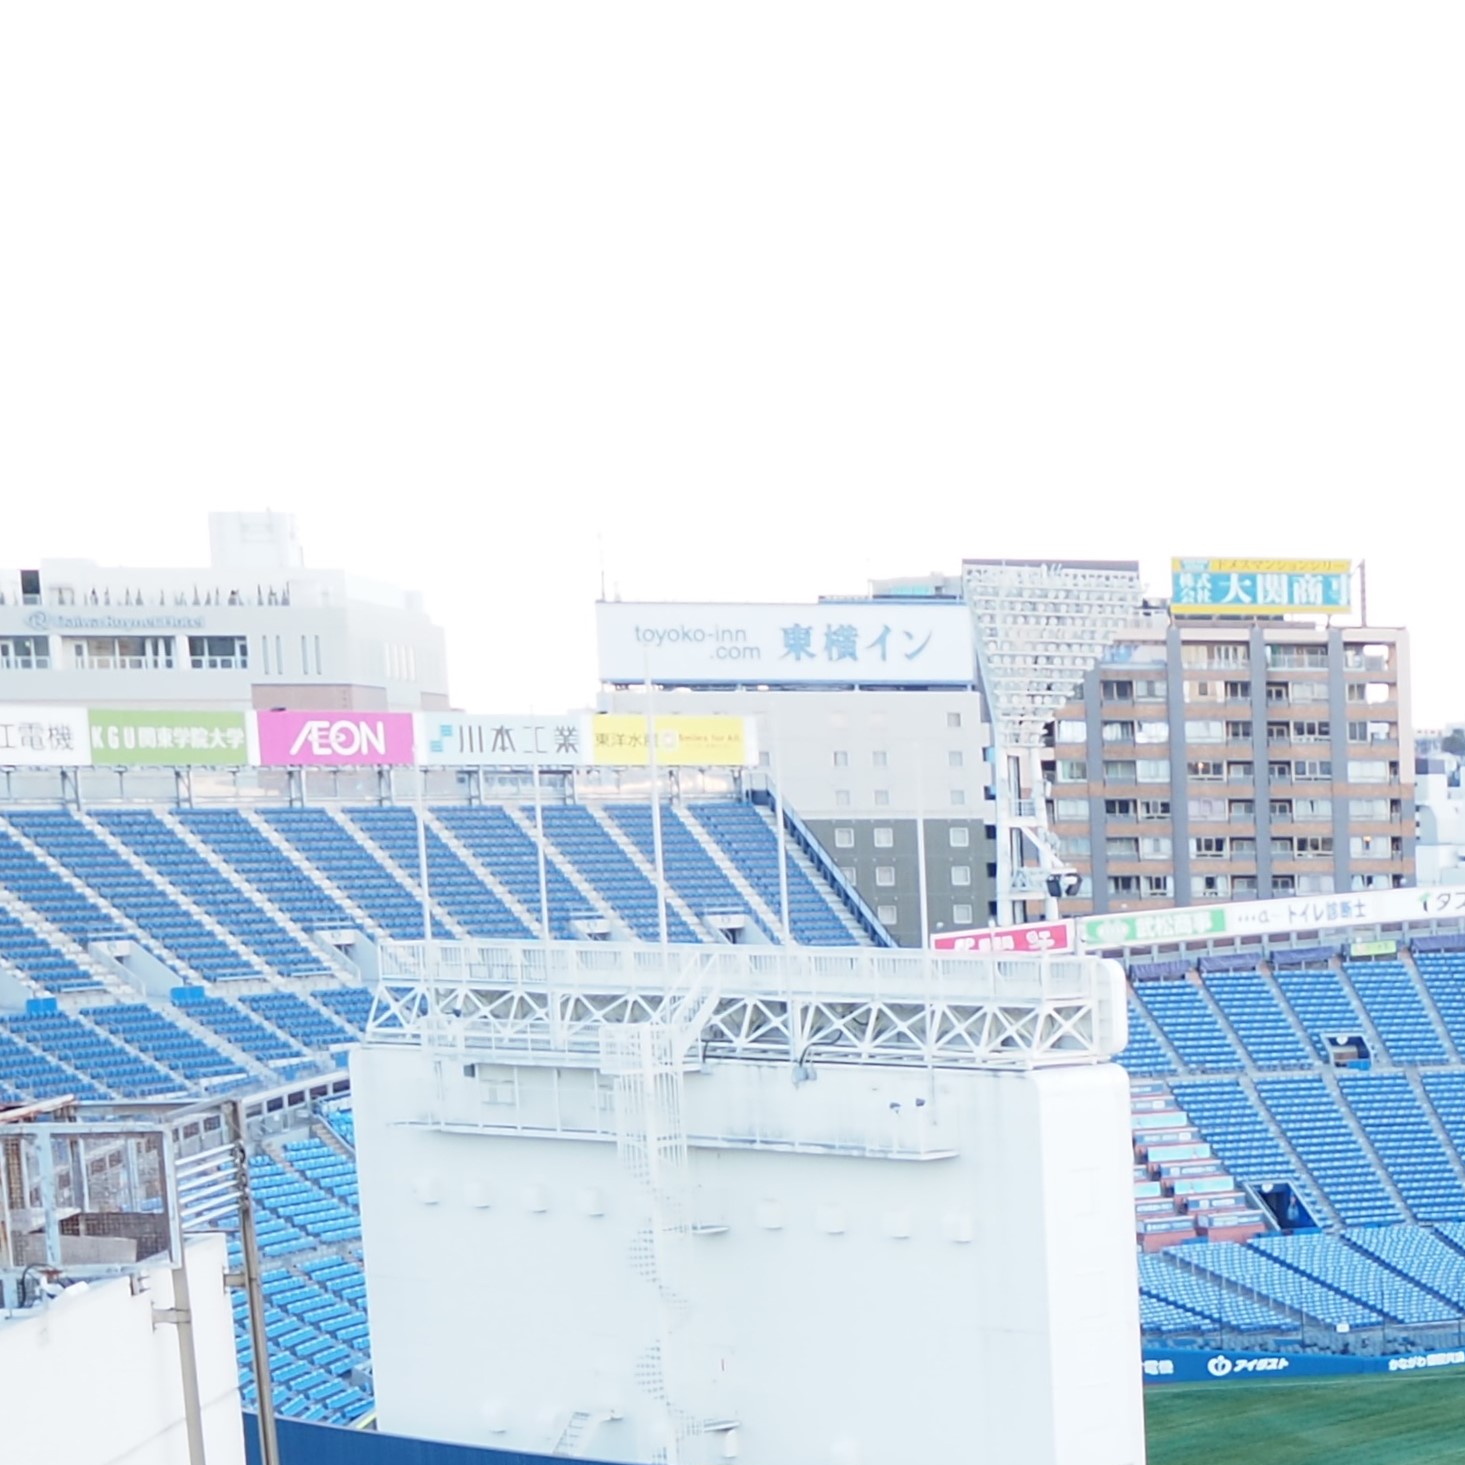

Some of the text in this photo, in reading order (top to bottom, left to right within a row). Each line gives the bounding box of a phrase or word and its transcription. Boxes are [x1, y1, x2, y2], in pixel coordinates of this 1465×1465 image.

[634, 623, 748, 646] toyoko-inn
[779, 623, 934, 662] 東横イン
[709, 645, 761, 661] .com
[138, 725, 245, 750] 関東学院大学
[458, 723, 580, 755] 川本工業
